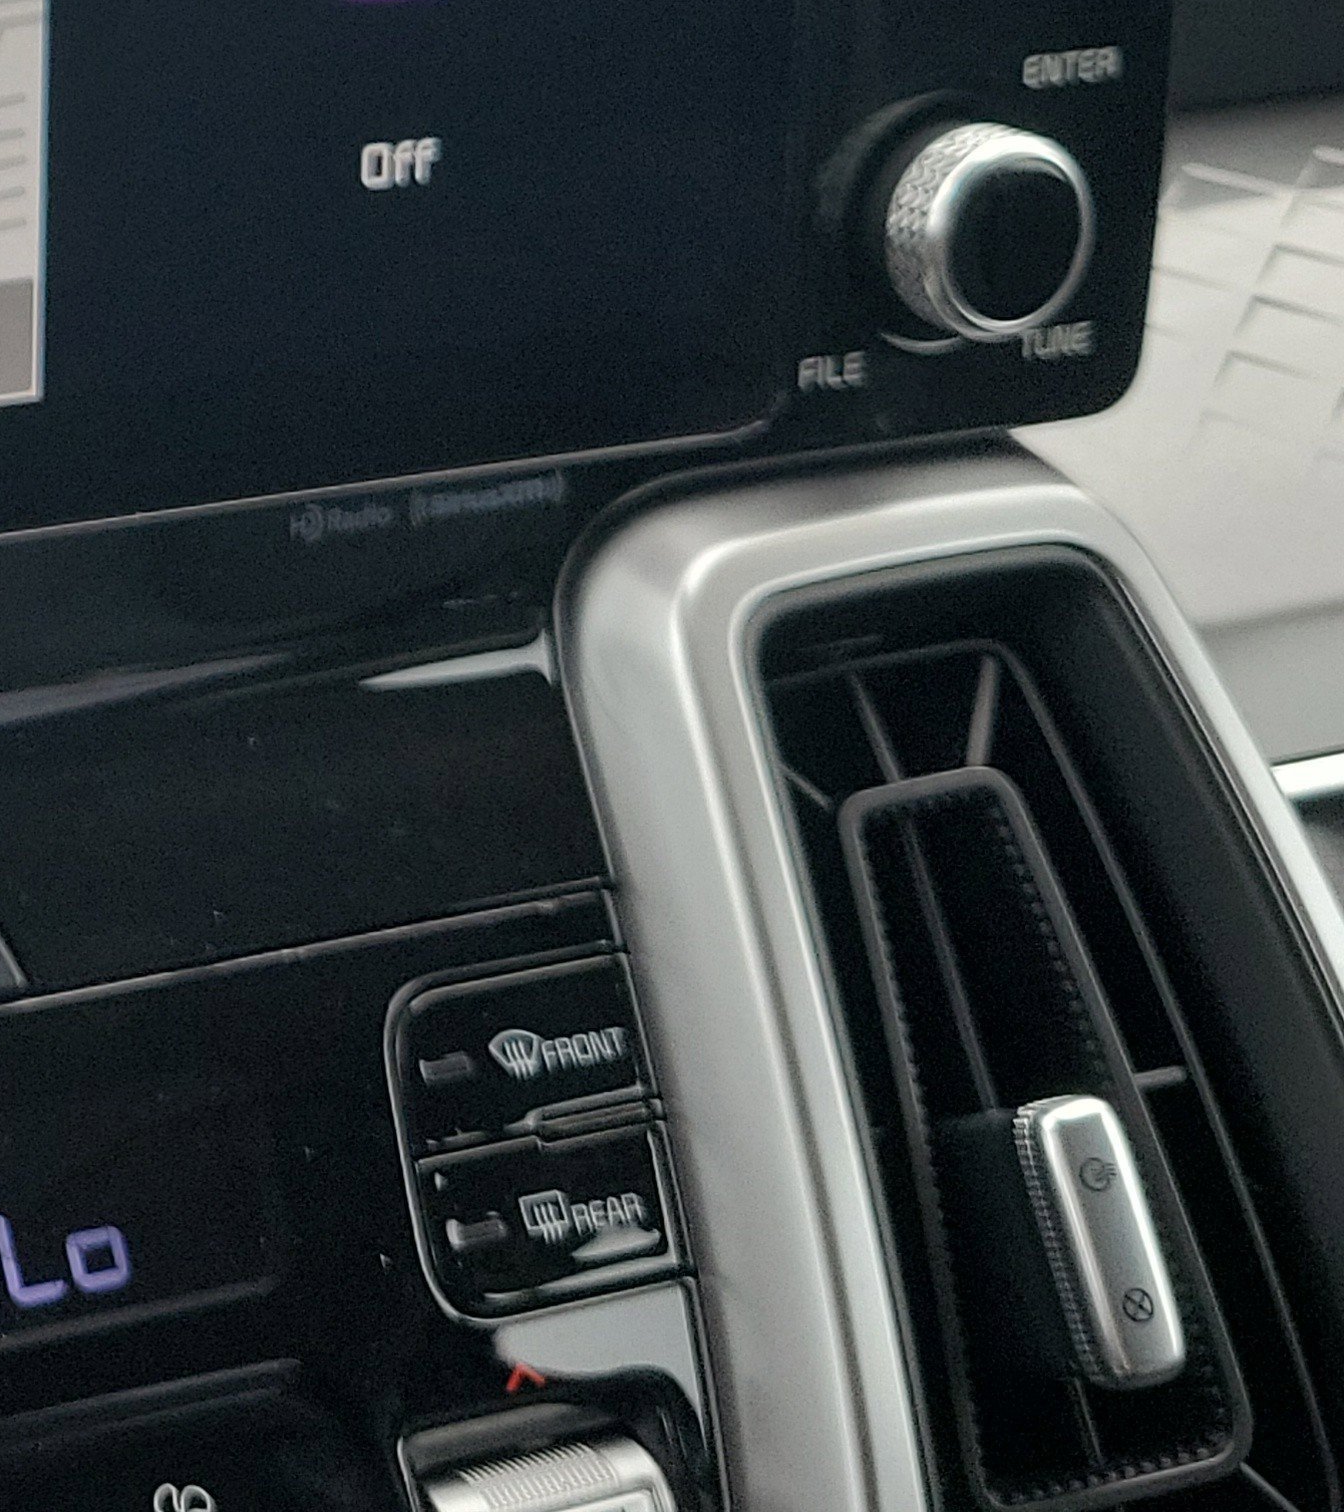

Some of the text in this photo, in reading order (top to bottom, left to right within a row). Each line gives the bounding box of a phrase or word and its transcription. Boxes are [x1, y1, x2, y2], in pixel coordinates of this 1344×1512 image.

[1022, 45, 1123, 89] ENTER
[359, 136, 443, 191] Off
[1018, 320, 1096, 361] TUNE
[797, 350, 868, 390] FILE
[540, 1025, 630, 1072] FRONT
[570, 1191, 646, 1238] REAR
